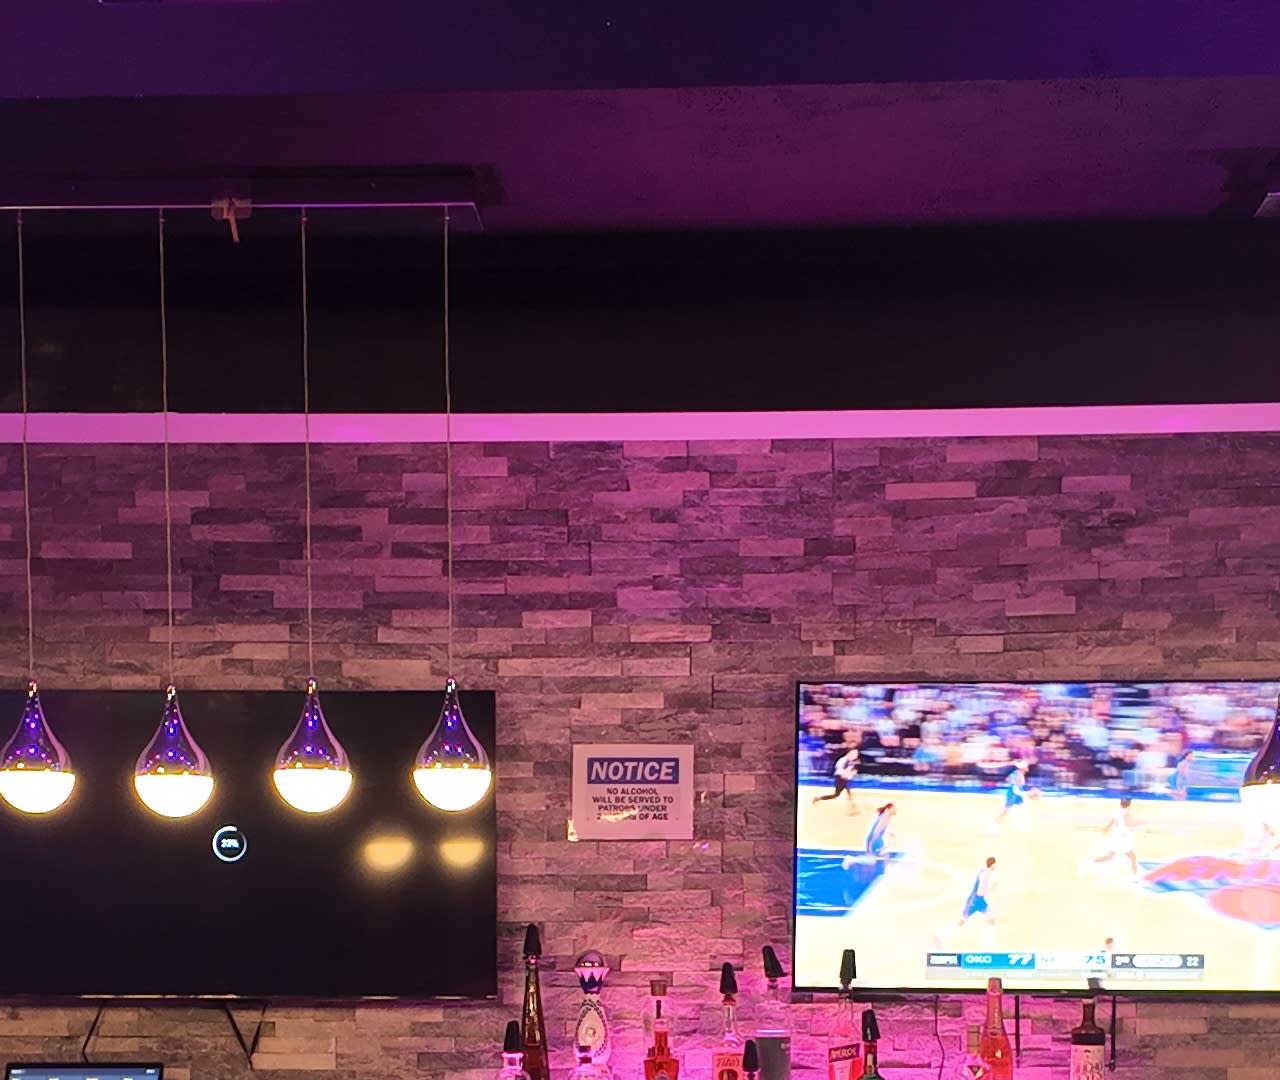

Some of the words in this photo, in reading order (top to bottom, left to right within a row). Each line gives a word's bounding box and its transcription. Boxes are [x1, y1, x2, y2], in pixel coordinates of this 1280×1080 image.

[591, 761, 676, 781] NOTICE
[592, 796, 613, 804] WILL
[615, 796, 626, 804] BE
[627, 796, 661, 804] SERVED
[663, 796, 674, 804] TO
[1007, 955, 1033, 965] 77
[1084, 955, 1106, 964] 75
